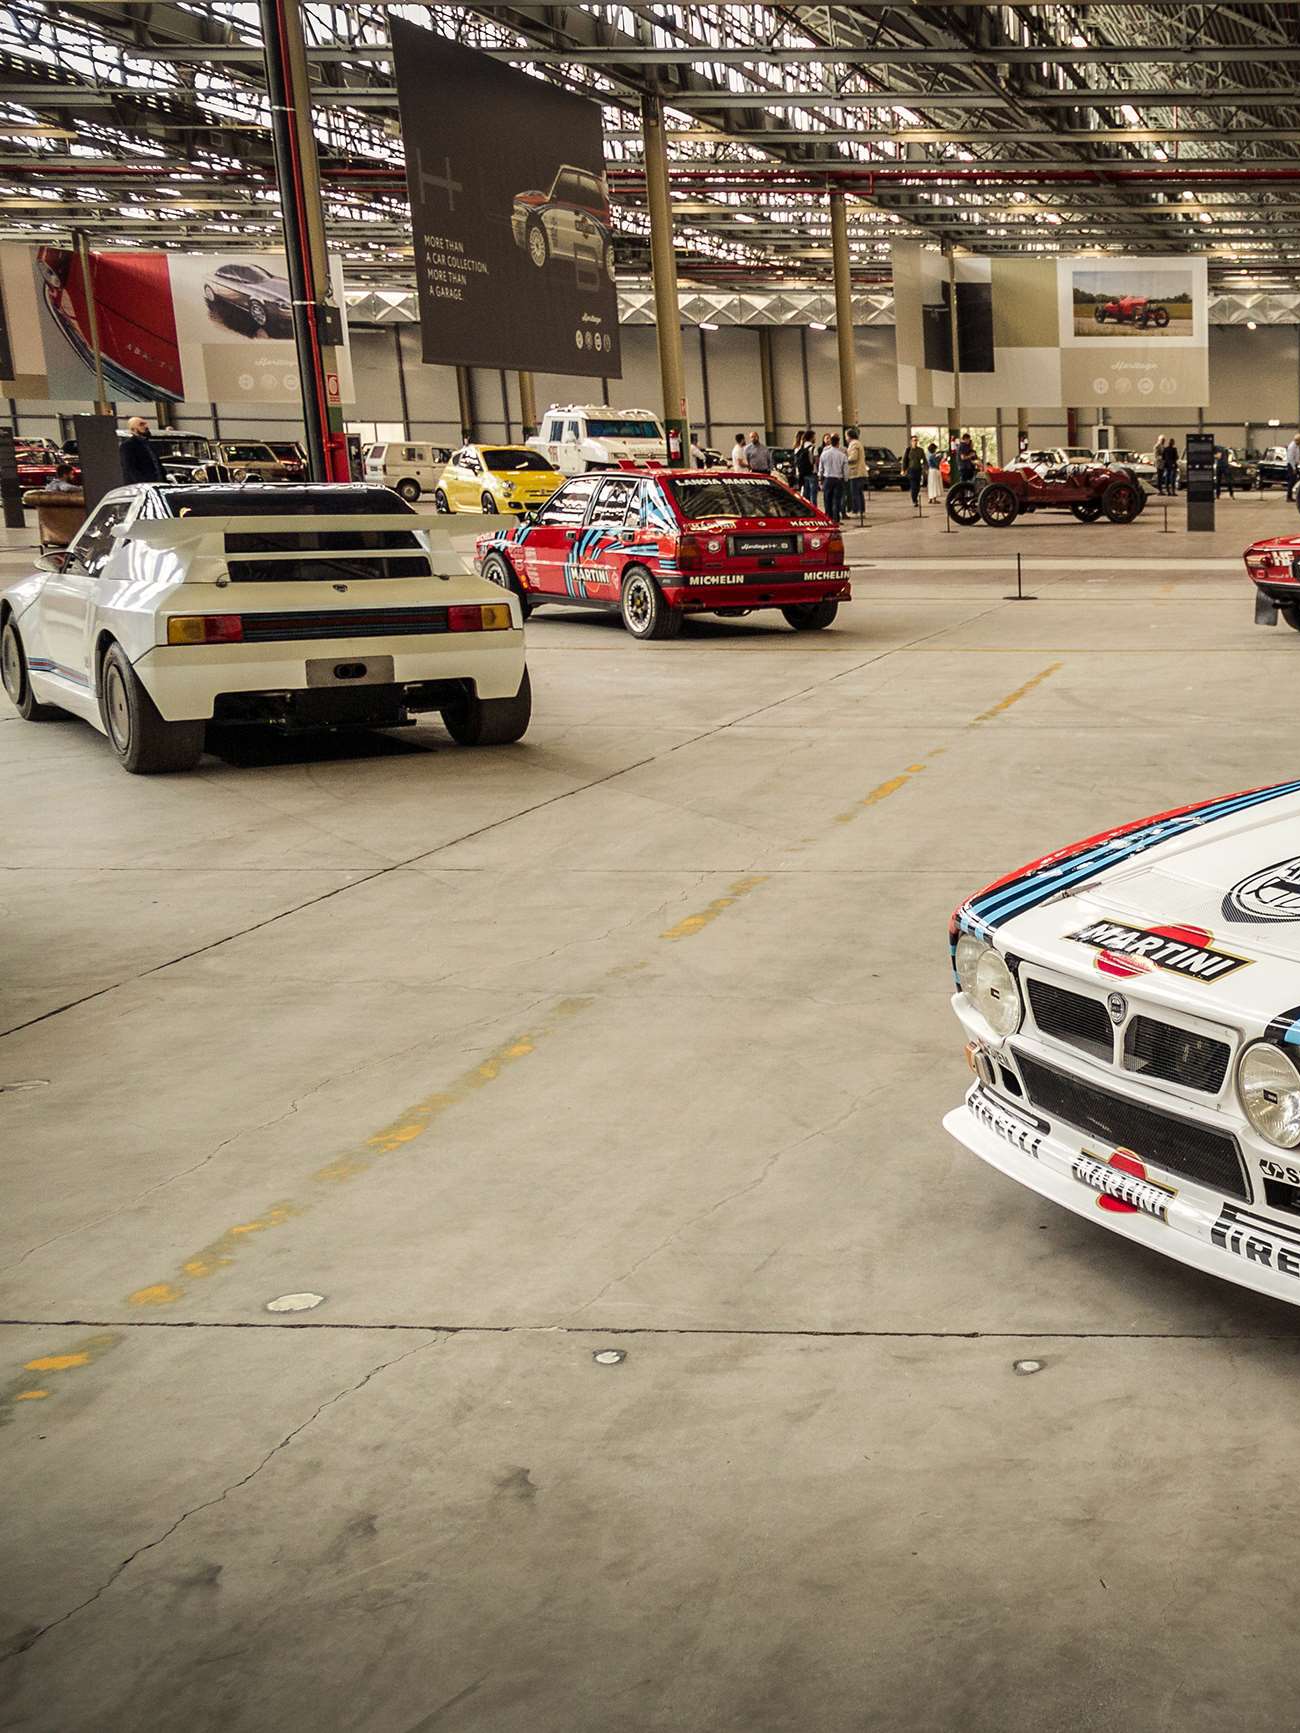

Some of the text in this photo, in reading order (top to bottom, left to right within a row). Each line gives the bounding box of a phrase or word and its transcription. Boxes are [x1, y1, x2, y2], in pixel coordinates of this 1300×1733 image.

[424, 235, 464, 254] MORE THAN
[426, 251, 431, 263] A
[433, 252, 446, 267] CAR
[427, 268, 467, 286] MORE THAN
[429, 285, 435, 297] A
[723, 478, 770, 486] MARTINI
[790, 520, 828, 528] MARTINI
[571, 568, 609, 583] MARTINI
[689, 570, 850, 586] MICHELIN MICHELIN
[1086, 922, 1236, 979] MARTINI
[1075, 1150, 1174, 1216] MARTINI
